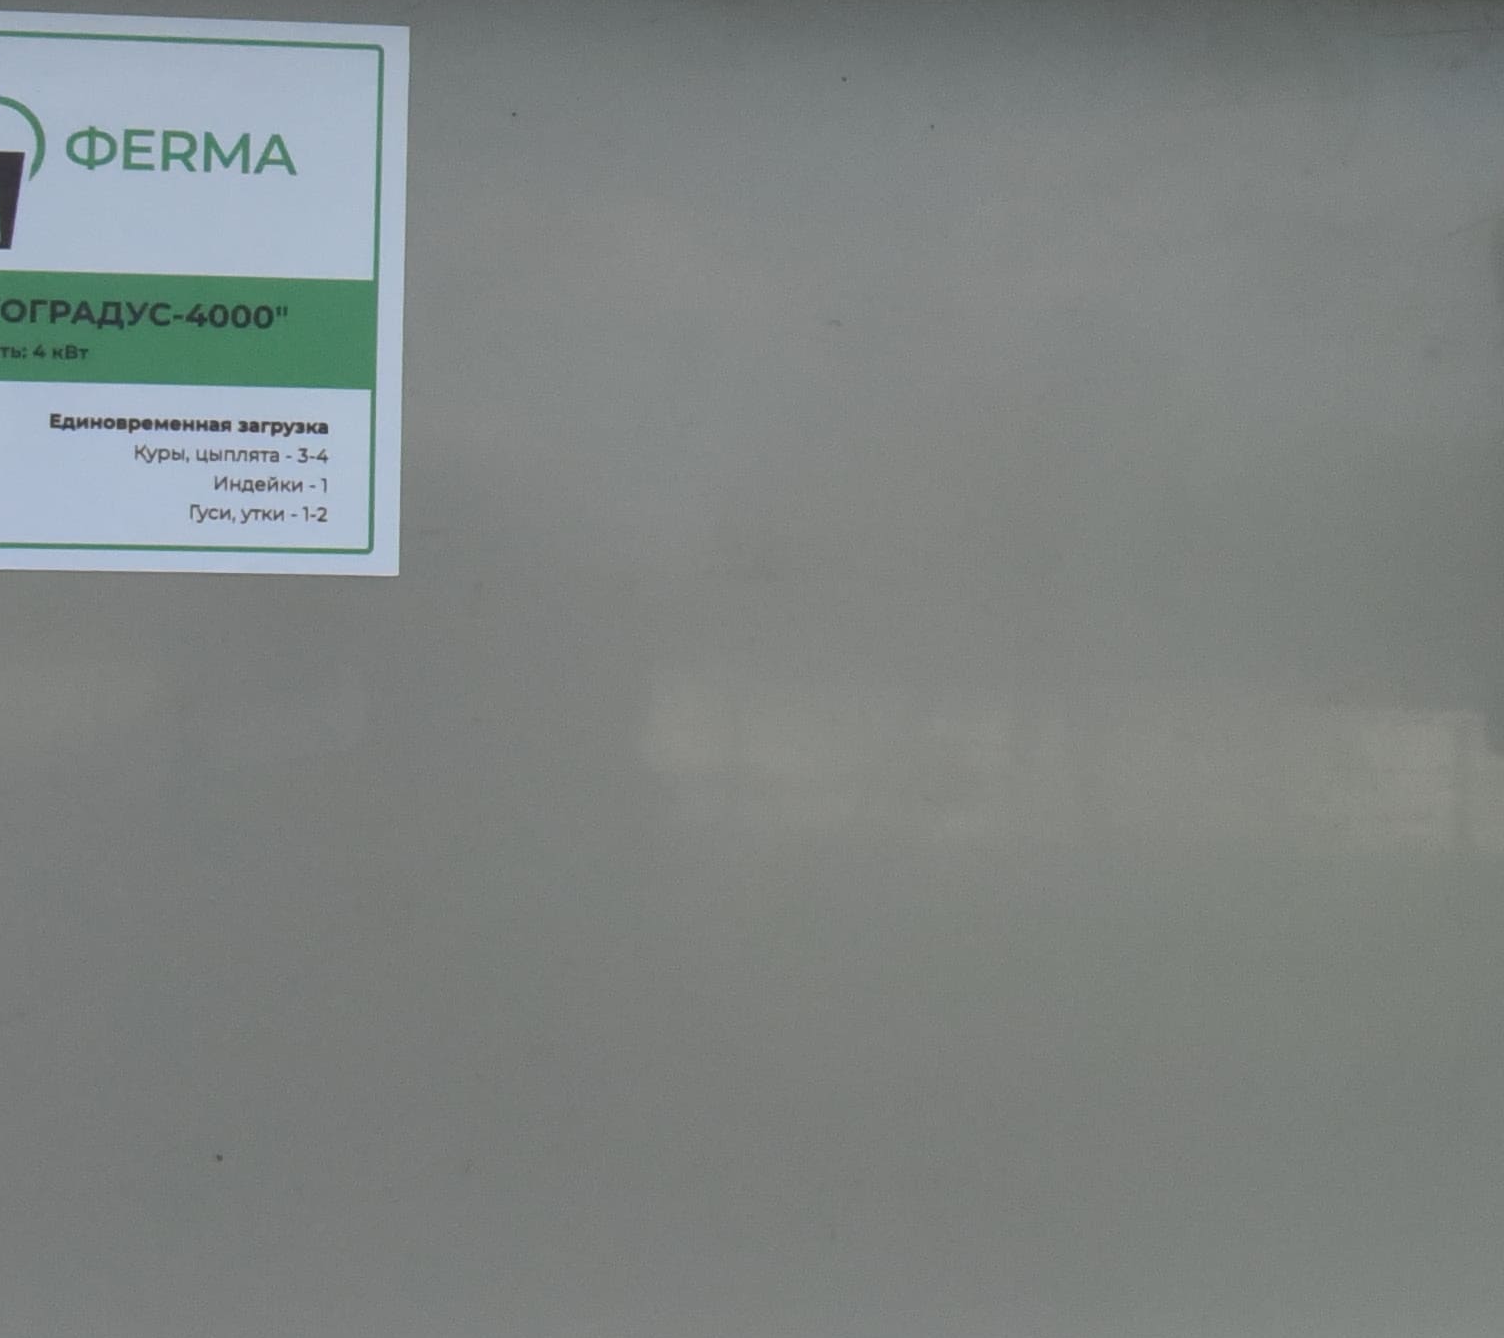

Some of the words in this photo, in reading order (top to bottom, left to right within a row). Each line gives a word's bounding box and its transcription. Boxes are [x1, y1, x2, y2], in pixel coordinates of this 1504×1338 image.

[32, 343, 47, 360] 4
[52, 344, 89, 361] кВт
[49, 413, 232, 434] Единовременная
[238, 419, 329, 436] загрузка
[134, 444, 190, 464] Куры,
[195, 447, 280, 464] цыплята
[297, 447, 329, 464] 3-4
[213, 475, 303, 493] Индейки
[321, 478, 328, 493] 1
[189, 504, 237, 524] Гуси,
[240, 507, 285, 524] утки
[302, 507, 328, 523] 1-2
